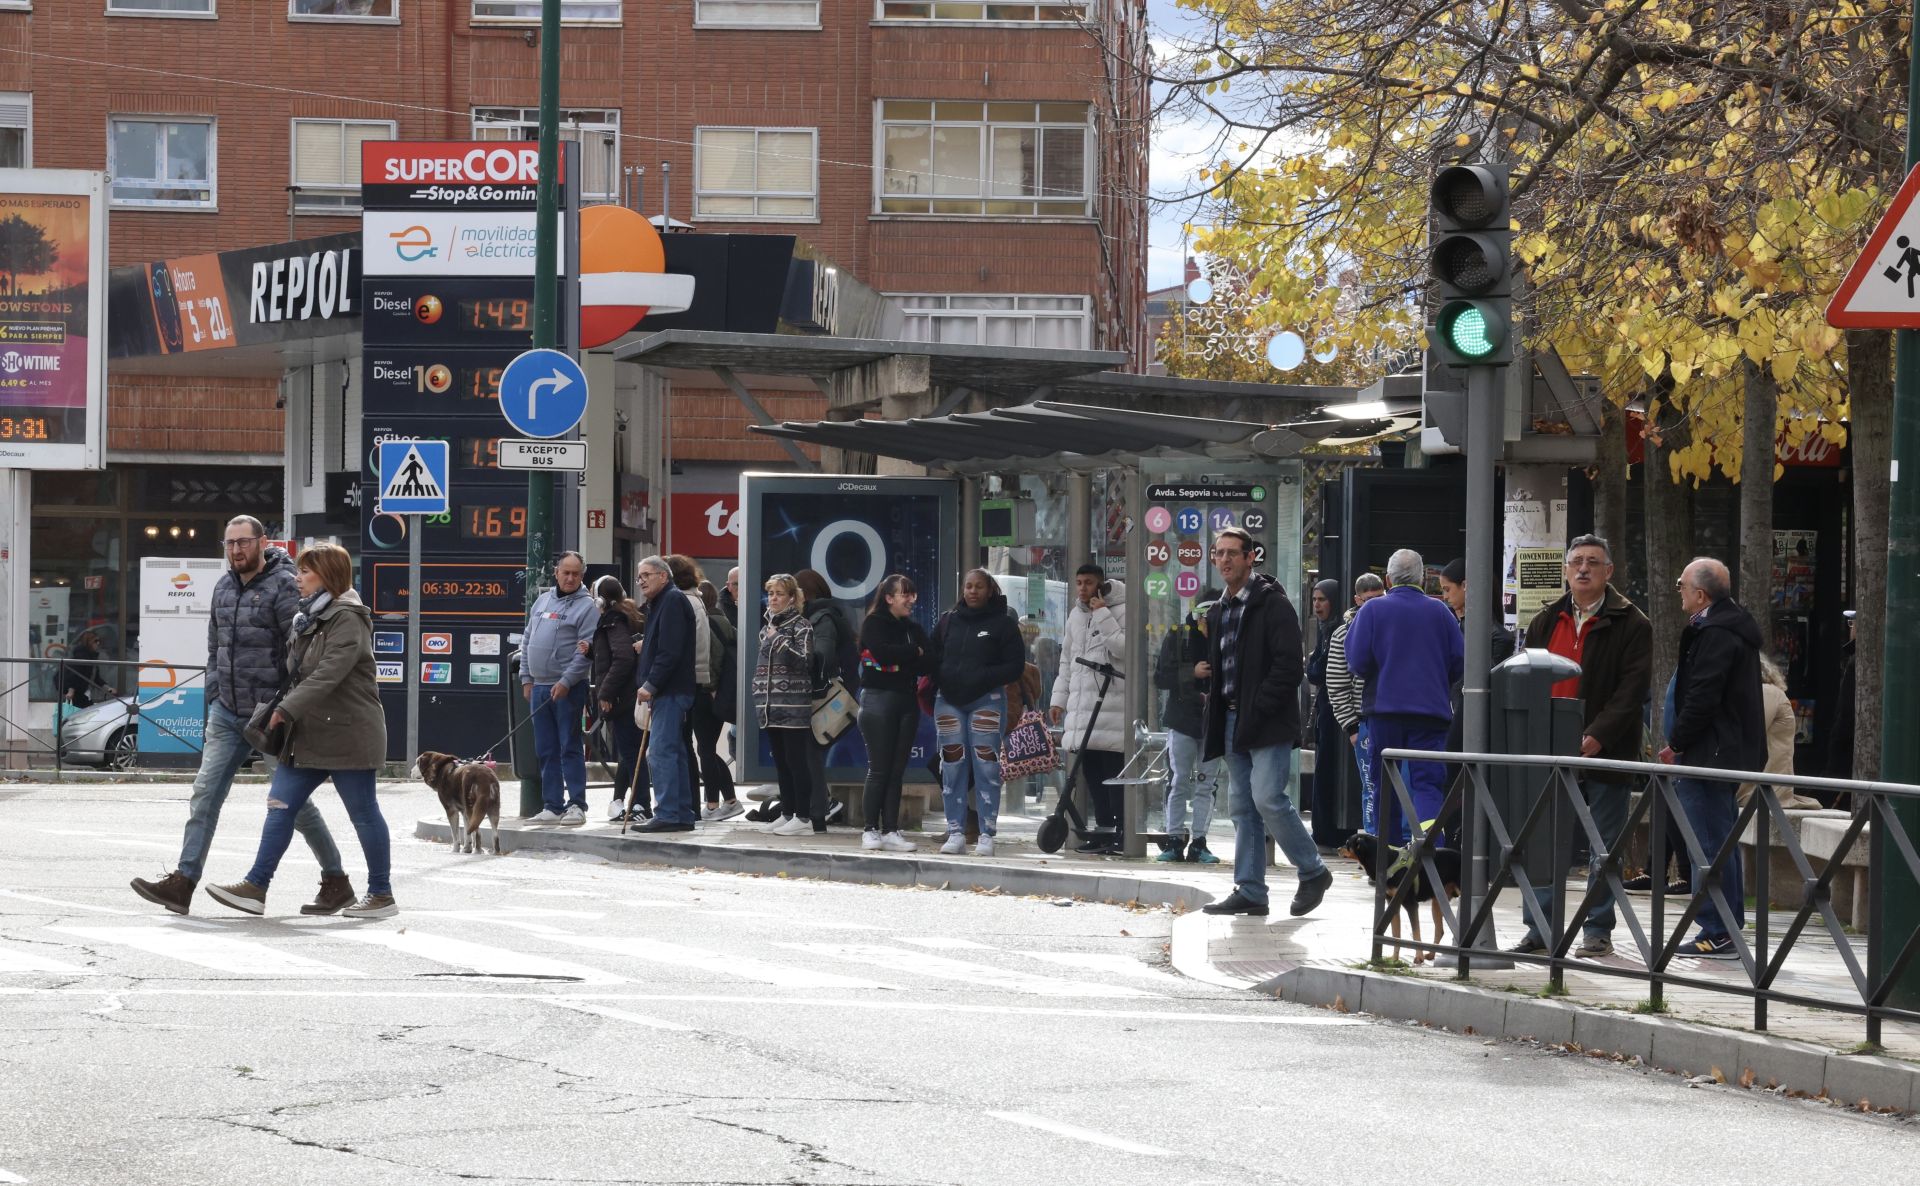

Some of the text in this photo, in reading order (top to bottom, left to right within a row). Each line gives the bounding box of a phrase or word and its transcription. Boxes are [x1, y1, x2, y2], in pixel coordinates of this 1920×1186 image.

[384, 149, 539, 181] SUPERCOR
[31, 200, 80, 209] ESPERADO
[173, 270, 196, 292] Ahorra
[250, 249, 350, 323] REPSOL
[373, 298, 412, 310] Diesel
[187, 297, 226, 342] 5 20
[474, 300, 527, 329] 1.49
[2, 351, 61, 373] SHOWTIME
[373, 367, 412, 379] Diesel
[519, 446, 567, 455] EXCEPTO
[532, 457, 554, 465] BUS
[838, 483, 877, 491] JCDecaux
[1155, 488, 1177, 496] Avda.
[1179, 489, 1211, 498] Segovia
[472, 508, 527, 537] 1.69
[1153, 513, 1164, 527] 6
[1180, 514, 1199, 529] 13
[1213, 514, 1232, 530] 14
[1246, 515, 1263, 528] C2
[1147, 546, 1169, 561] P6
[1178, 549, 1202, 558] PSC3
[1147, 580, 1167, 596] F2
[1177, 577, 1198, 590] LD
[378, 668, 399, 676] VISA
[1010, 725, 1035, 738] SHOP
[1008, 742, 1047, 758] OF LOVE
[1012, 739, 1041, 752] NAME
[911, 747, 925, 758] 51
